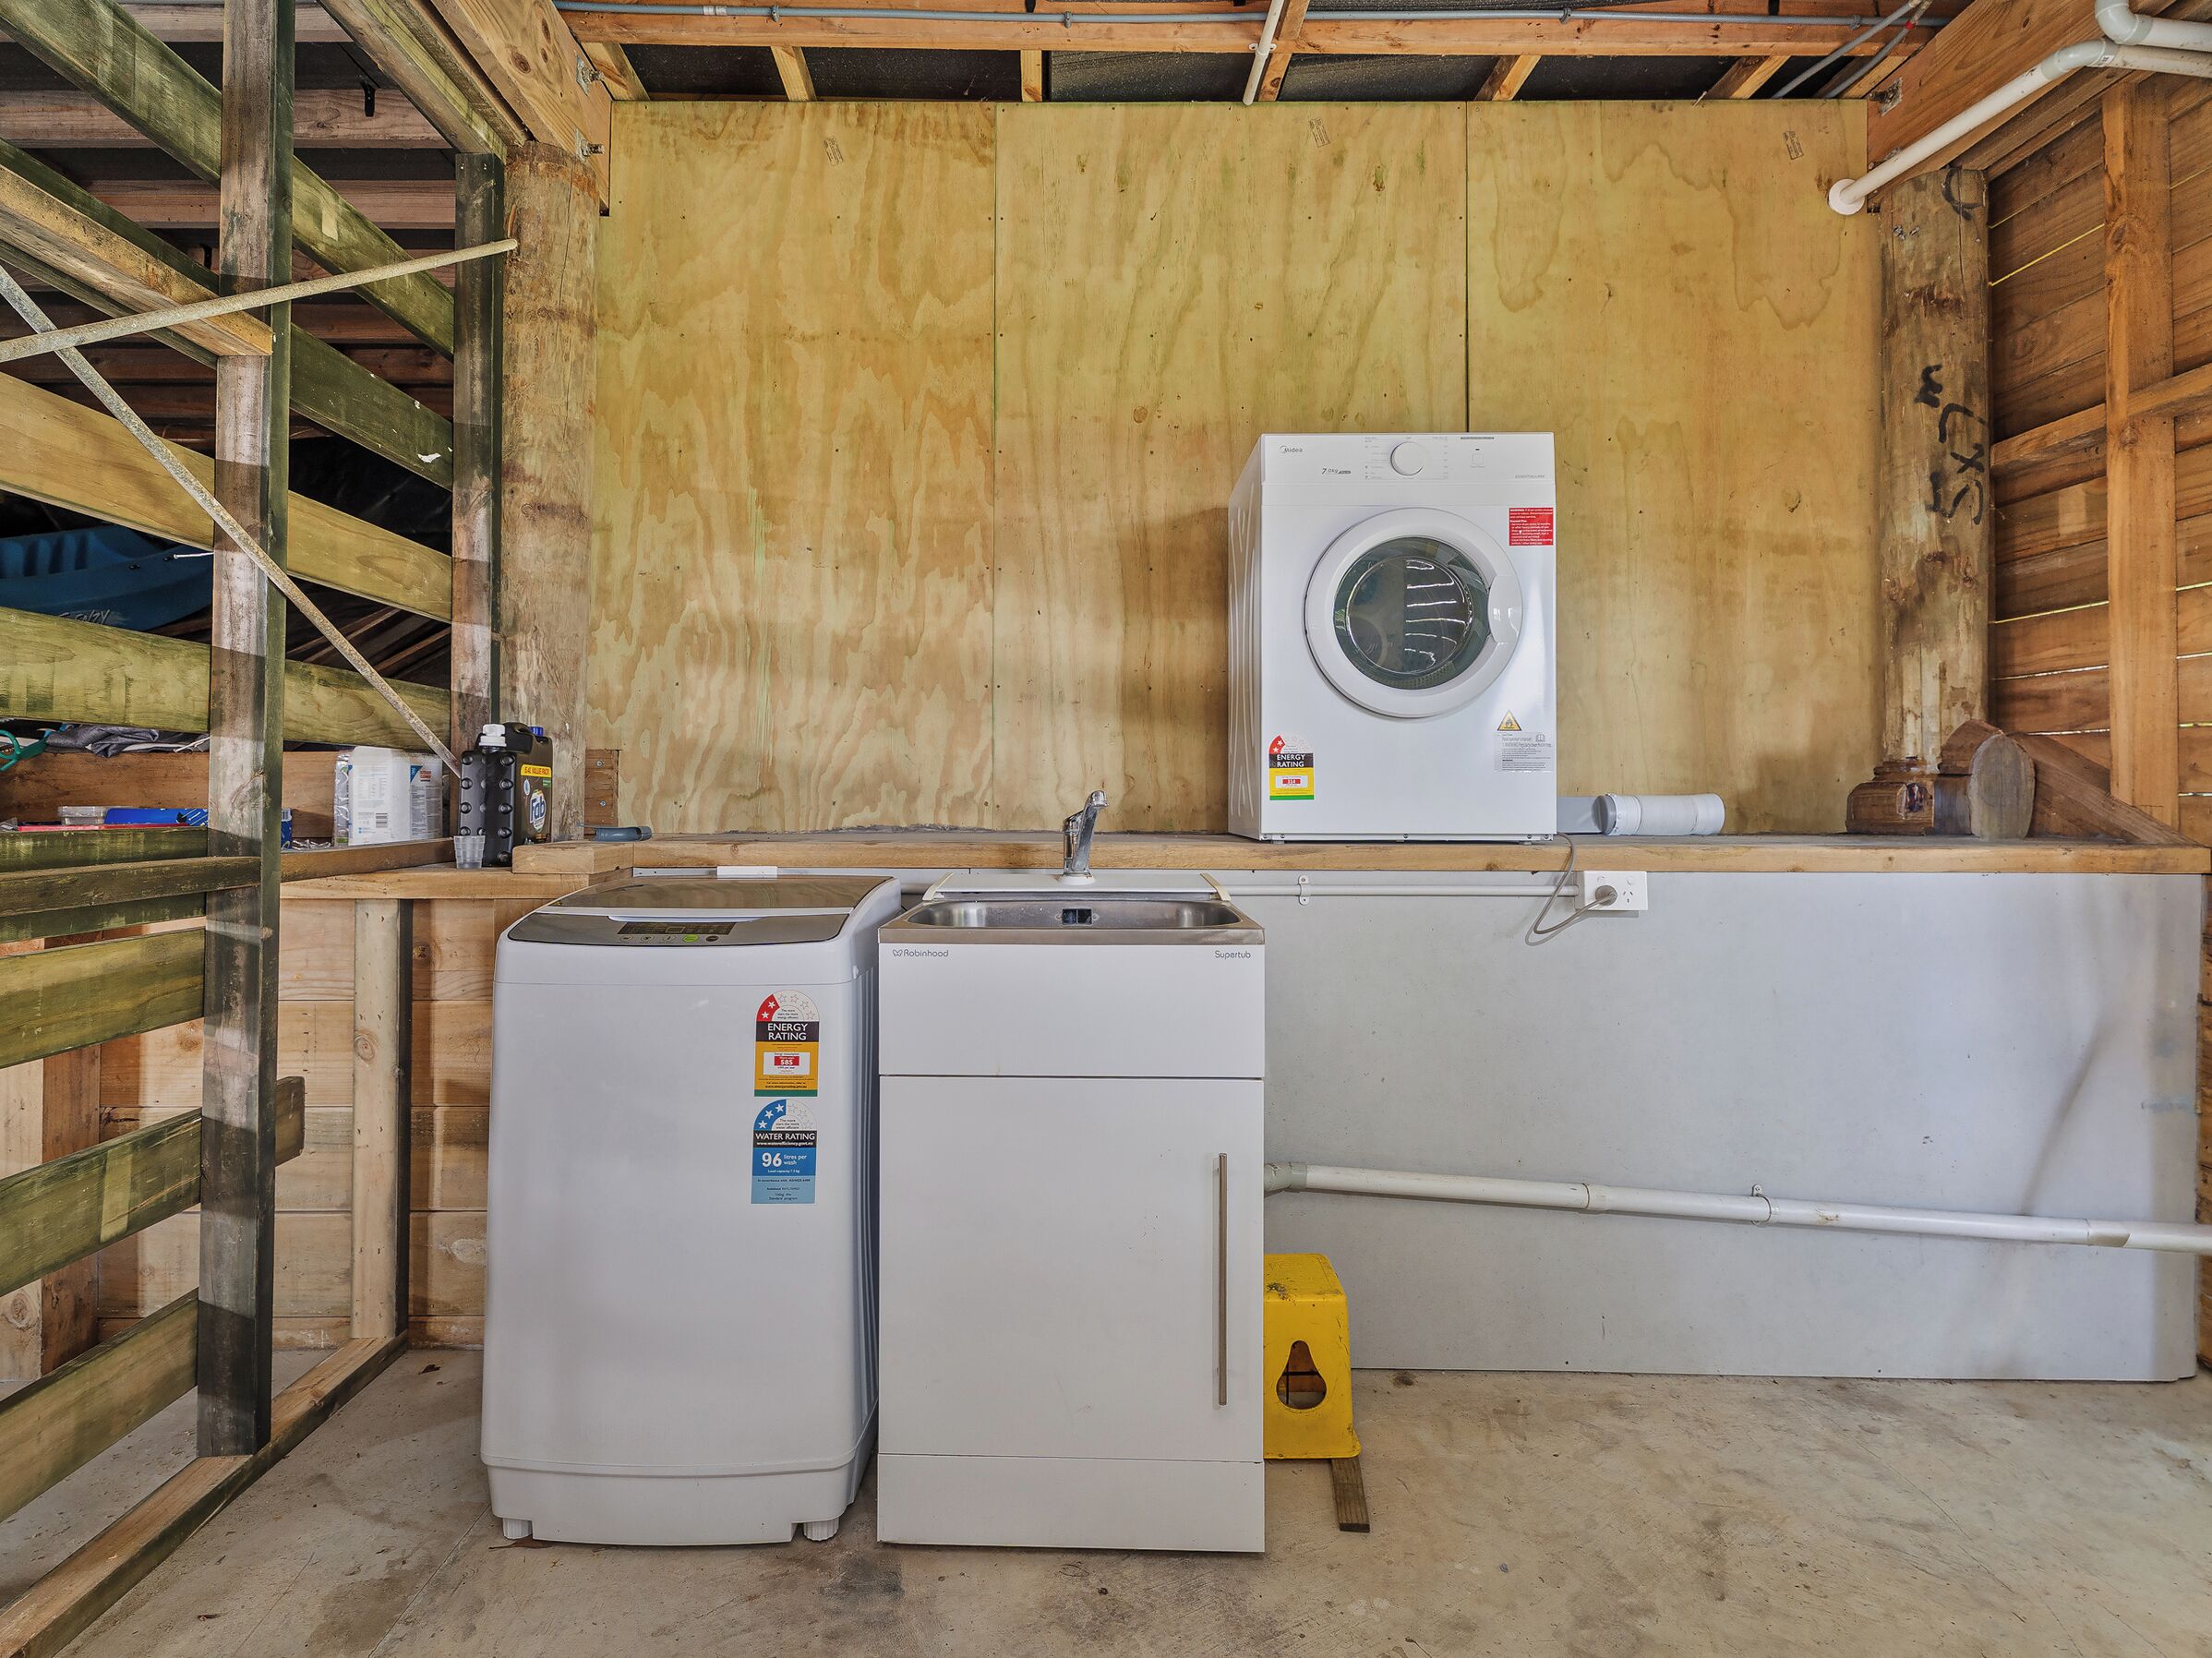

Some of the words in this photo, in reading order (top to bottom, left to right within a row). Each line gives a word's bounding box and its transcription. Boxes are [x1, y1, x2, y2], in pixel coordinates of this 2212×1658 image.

[1280, 445, 1303, 453] Midea
[531, 796, 546, 822] Fab
[1214, 950, 1251, 959] Supertub
[768, 1023, 808, 1031] ENERGY
[762, 1152, 782, 1167] 96
